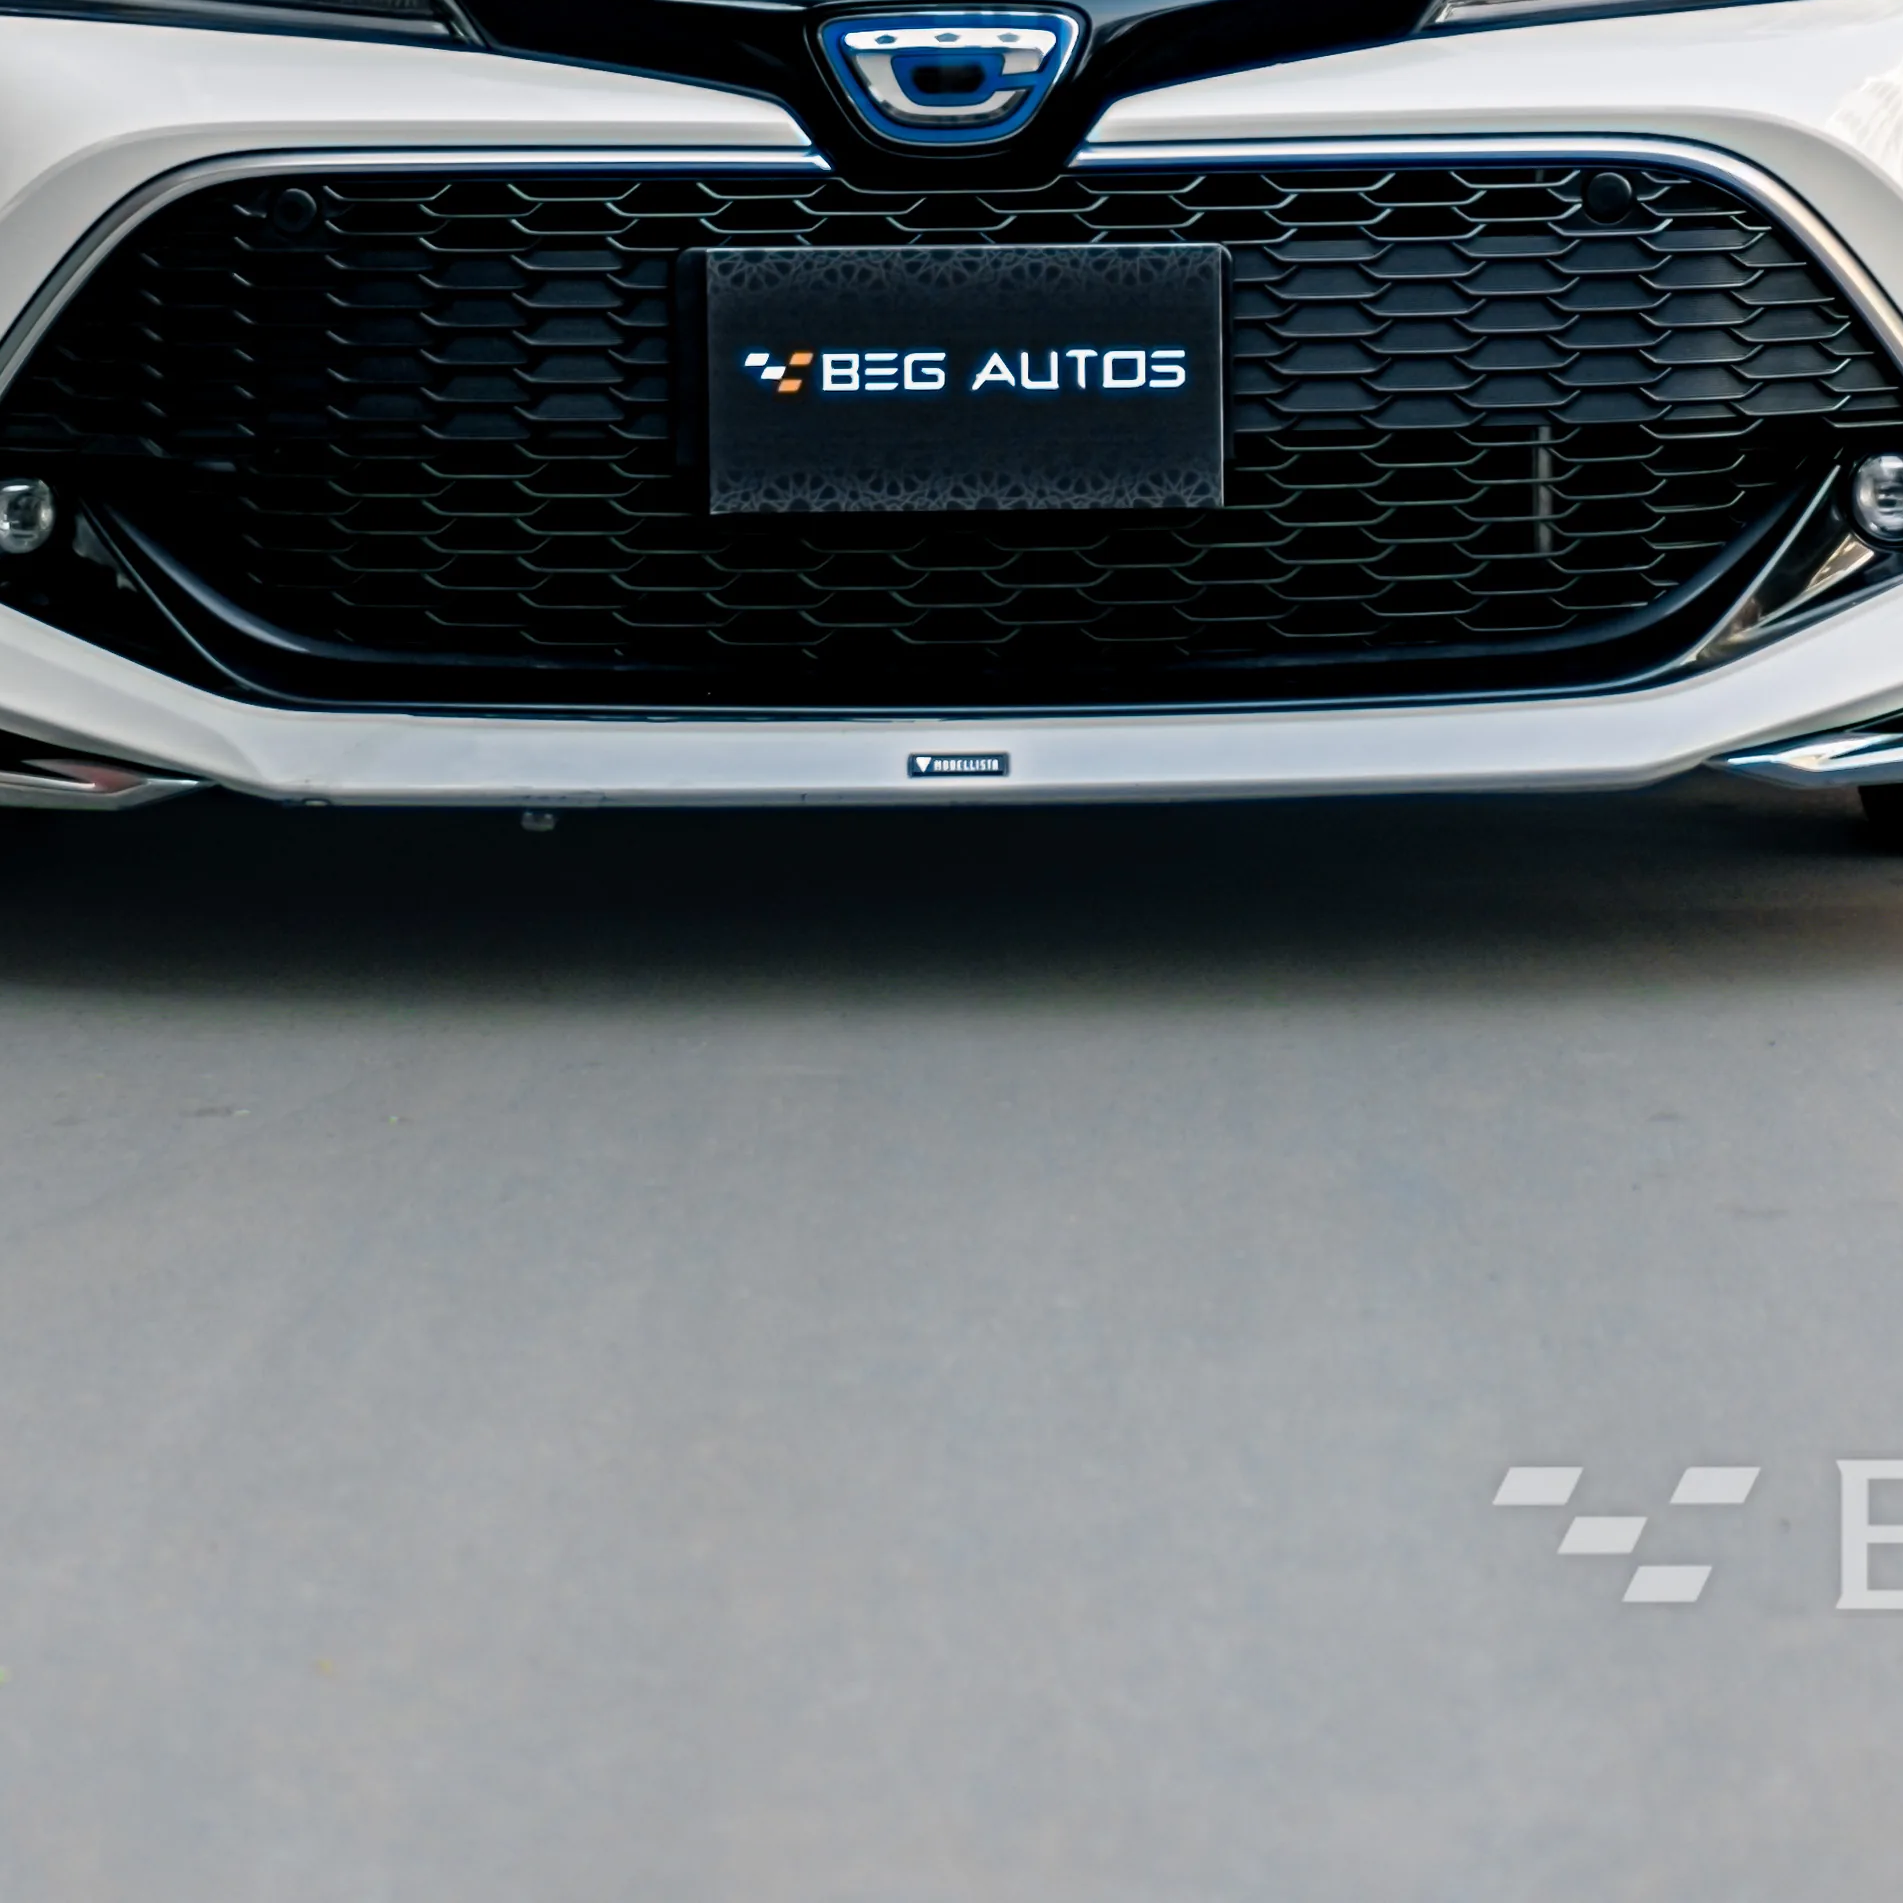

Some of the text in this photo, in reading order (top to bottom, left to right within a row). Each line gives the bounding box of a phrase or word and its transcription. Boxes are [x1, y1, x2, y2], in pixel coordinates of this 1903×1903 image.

[822, 349, 1187, 391] BEG AUTOS
[933, 758, 999, 772] MODELLISTA
